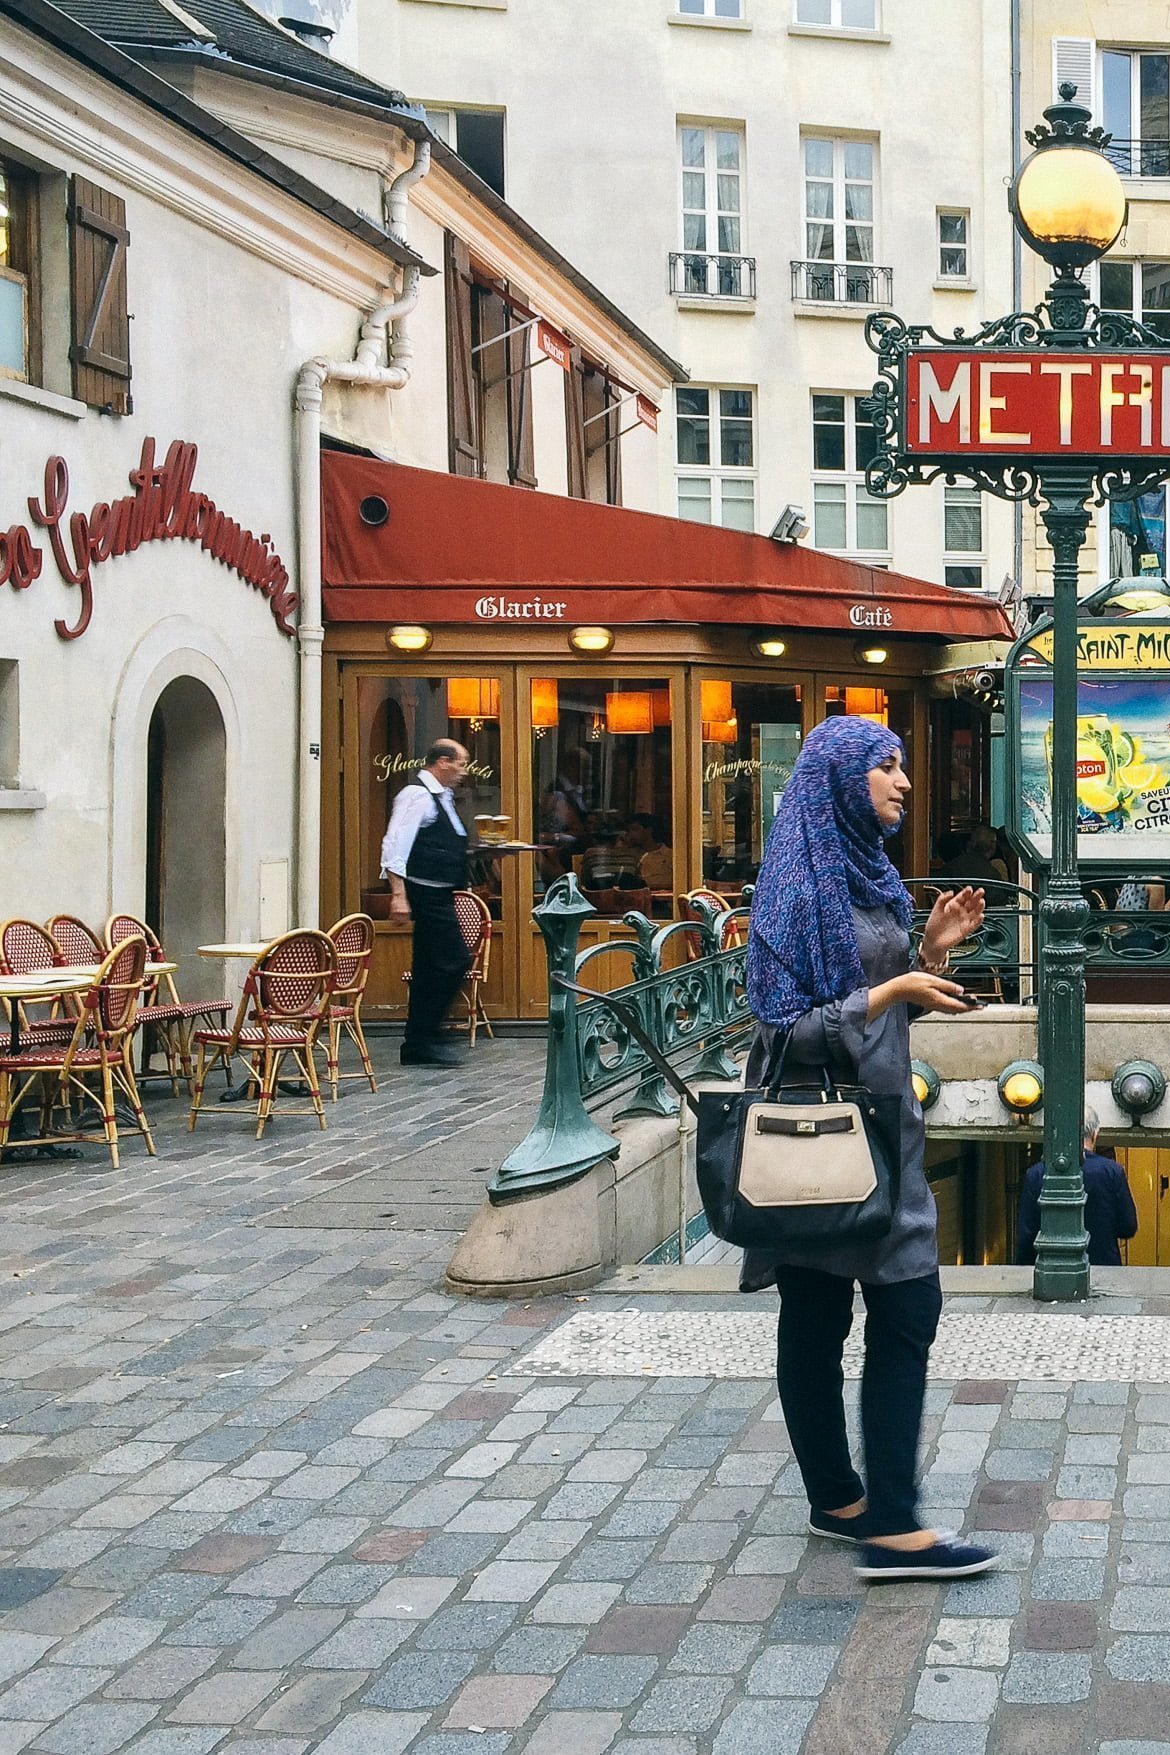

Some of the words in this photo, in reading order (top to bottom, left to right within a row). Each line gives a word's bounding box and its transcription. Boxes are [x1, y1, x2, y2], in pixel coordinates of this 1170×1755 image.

[0, 525, 42, 588] a
[475, 596, 567, 619] Glacier
[849, 603, 893, 627] Café
[1077, 763, 1102, 777] pton
